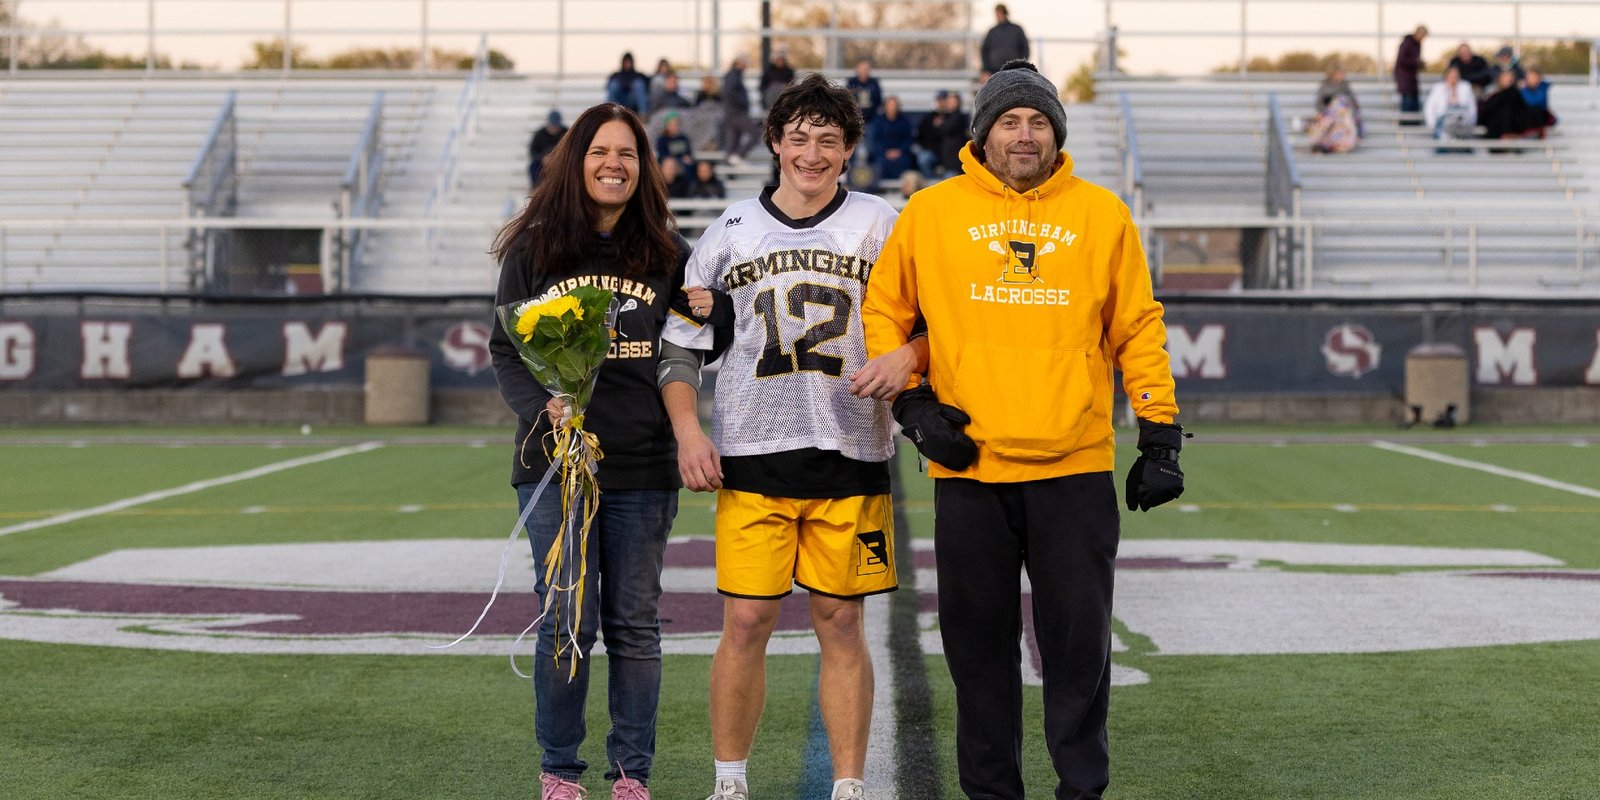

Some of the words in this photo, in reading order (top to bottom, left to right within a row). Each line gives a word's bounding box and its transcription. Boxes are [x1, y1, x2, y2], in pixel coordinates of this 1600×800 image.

[968, 219, 1077, 247] BIRMINGHAM
[724, 249, 874, 291] IRMINGH
[548, 275, 657, 306] BIRMINGHAM
[970, 283, 1070, 305] LACROSSE
[753, 281, 852, 379] 12
[606, 341, 652, 359] OSSE
